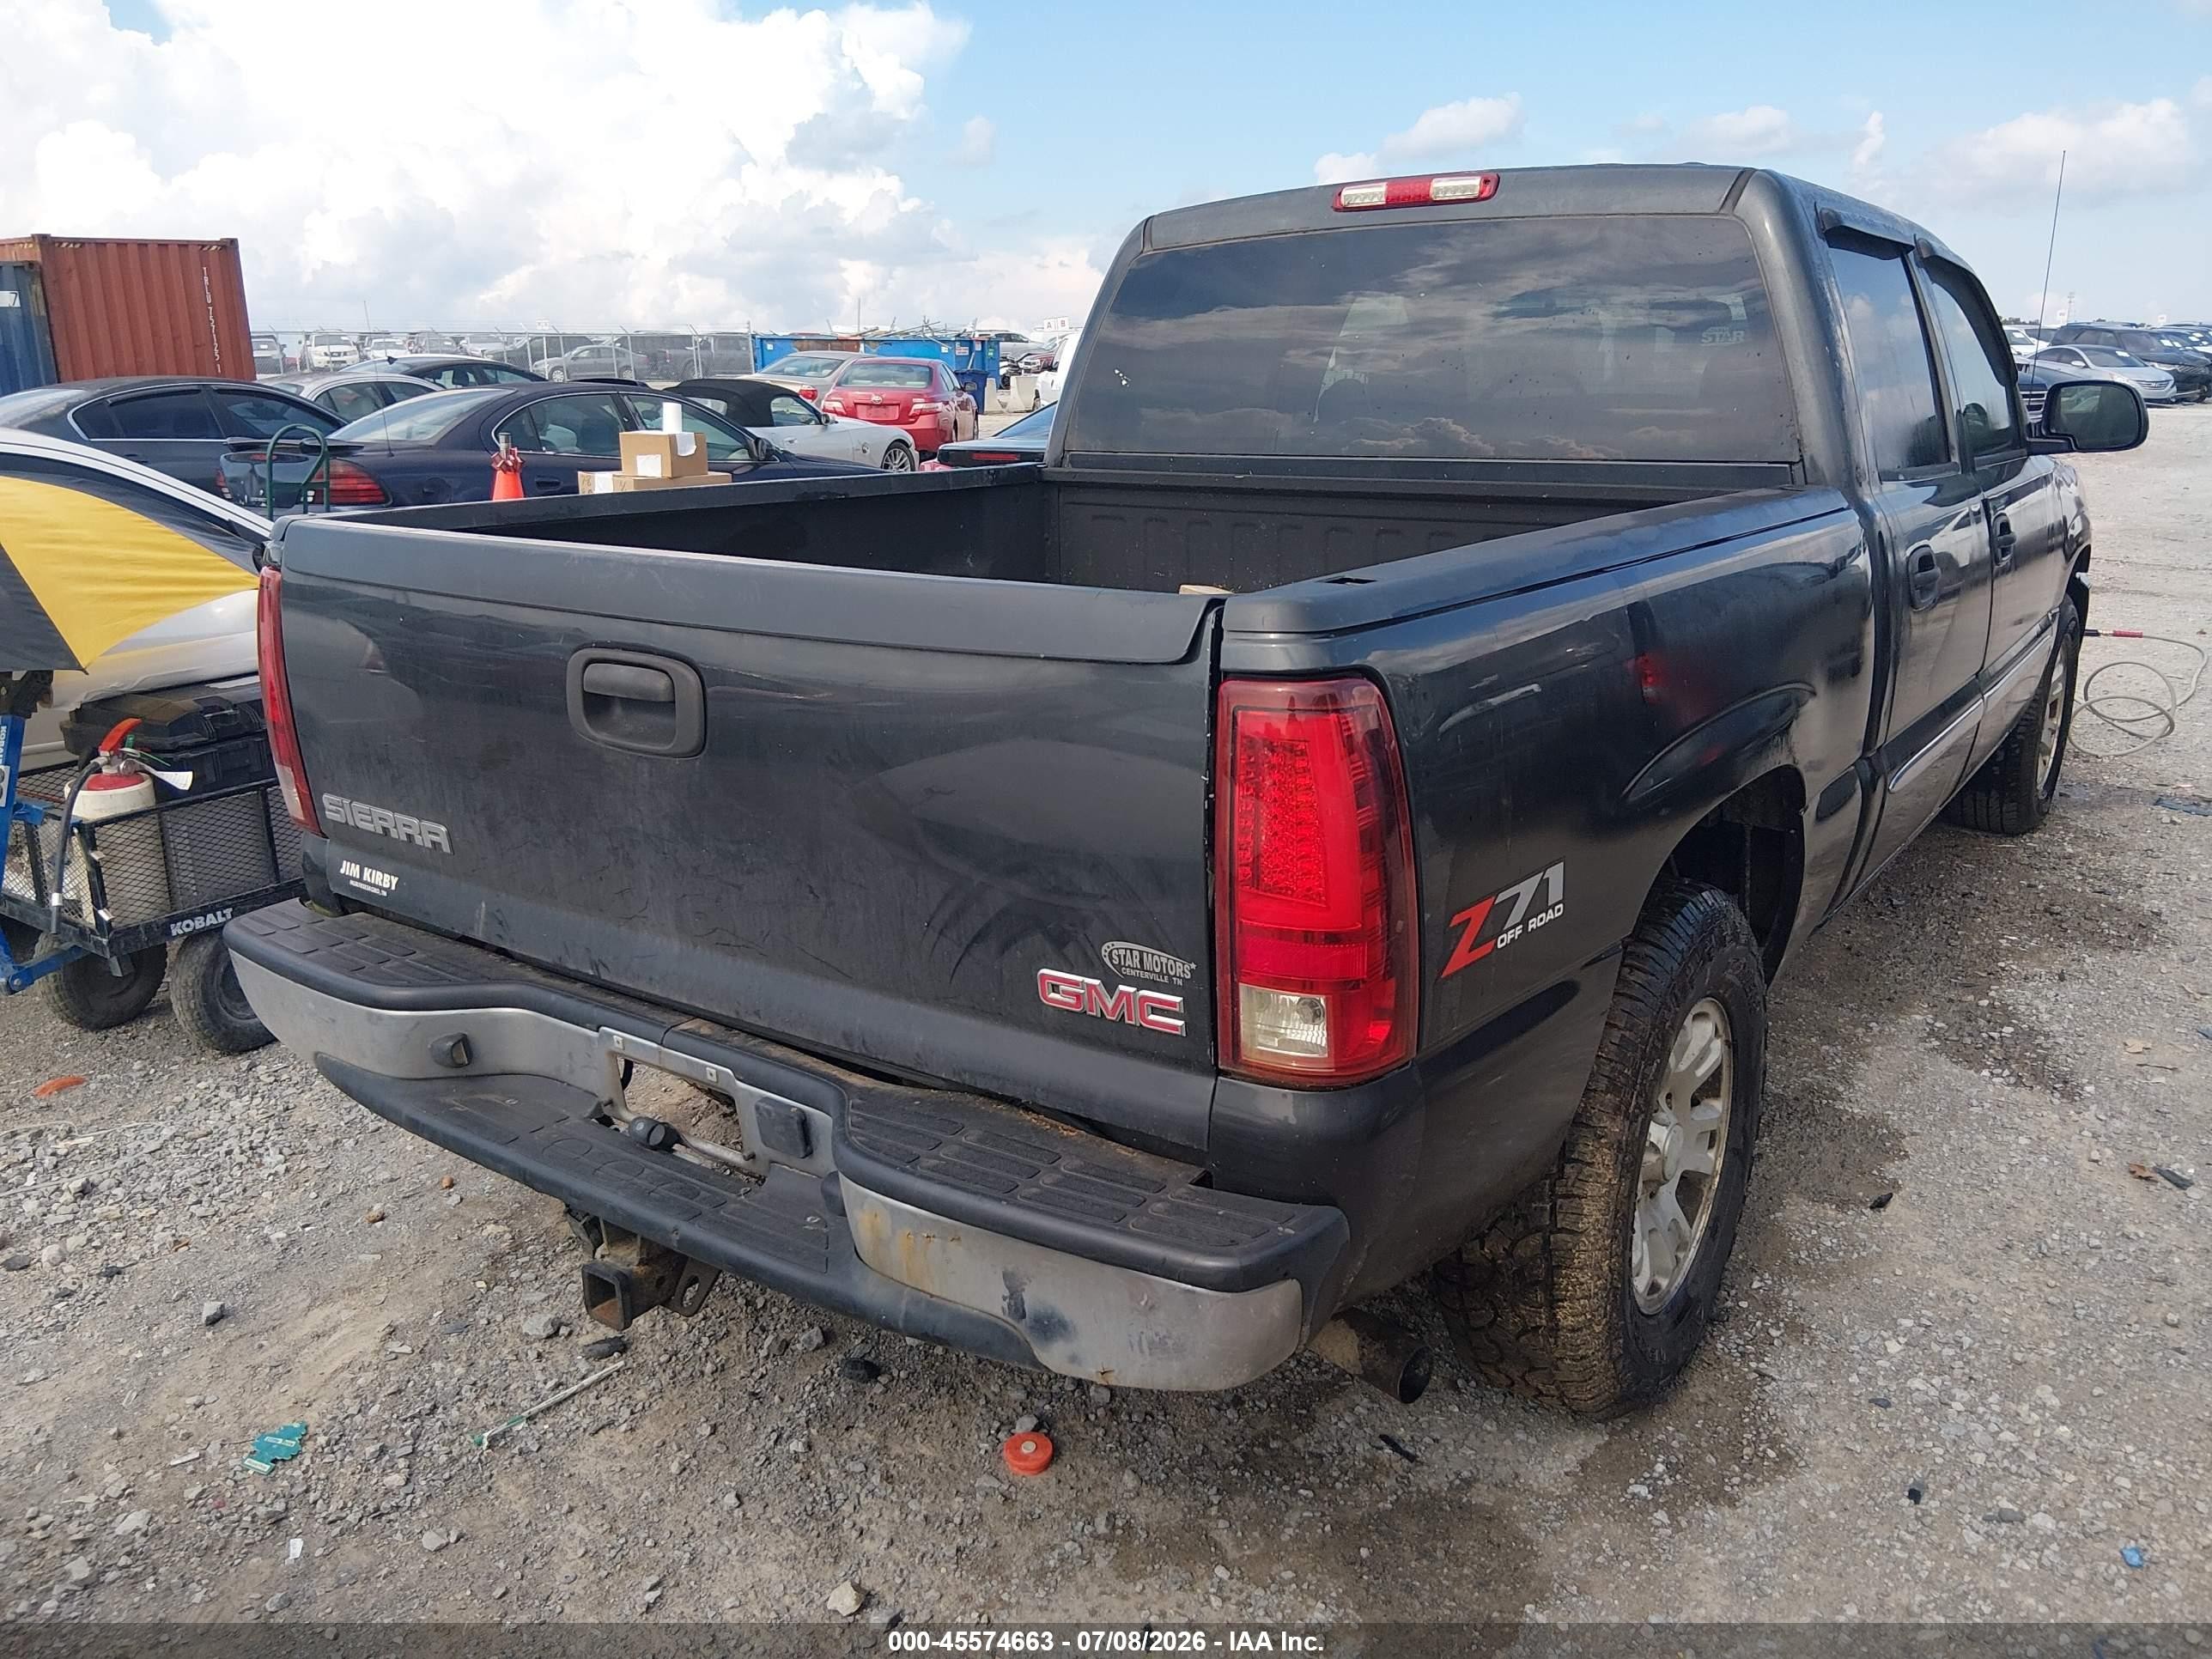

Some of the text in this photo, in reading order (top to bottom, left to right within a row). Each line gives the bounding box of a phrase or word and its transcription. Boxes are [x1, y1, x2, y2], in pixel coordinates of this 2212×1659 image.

[322, 793, 454, 855] SIERRA
[340, 860, 360, 879] JIM
[363, 866, 399, 890] KIRBY
[170, 908, 233, 936] KOBALT
[1442, 861, 1564, 978] Z71
[1497, 903, 1564, 949] OFF ROAD
[1112, 949, 1191, 980] STAR MOTORS
[1121, 968, 1183, 986] CENTERVILLE TN
[1037, 968, 1186, 1036] GMC
